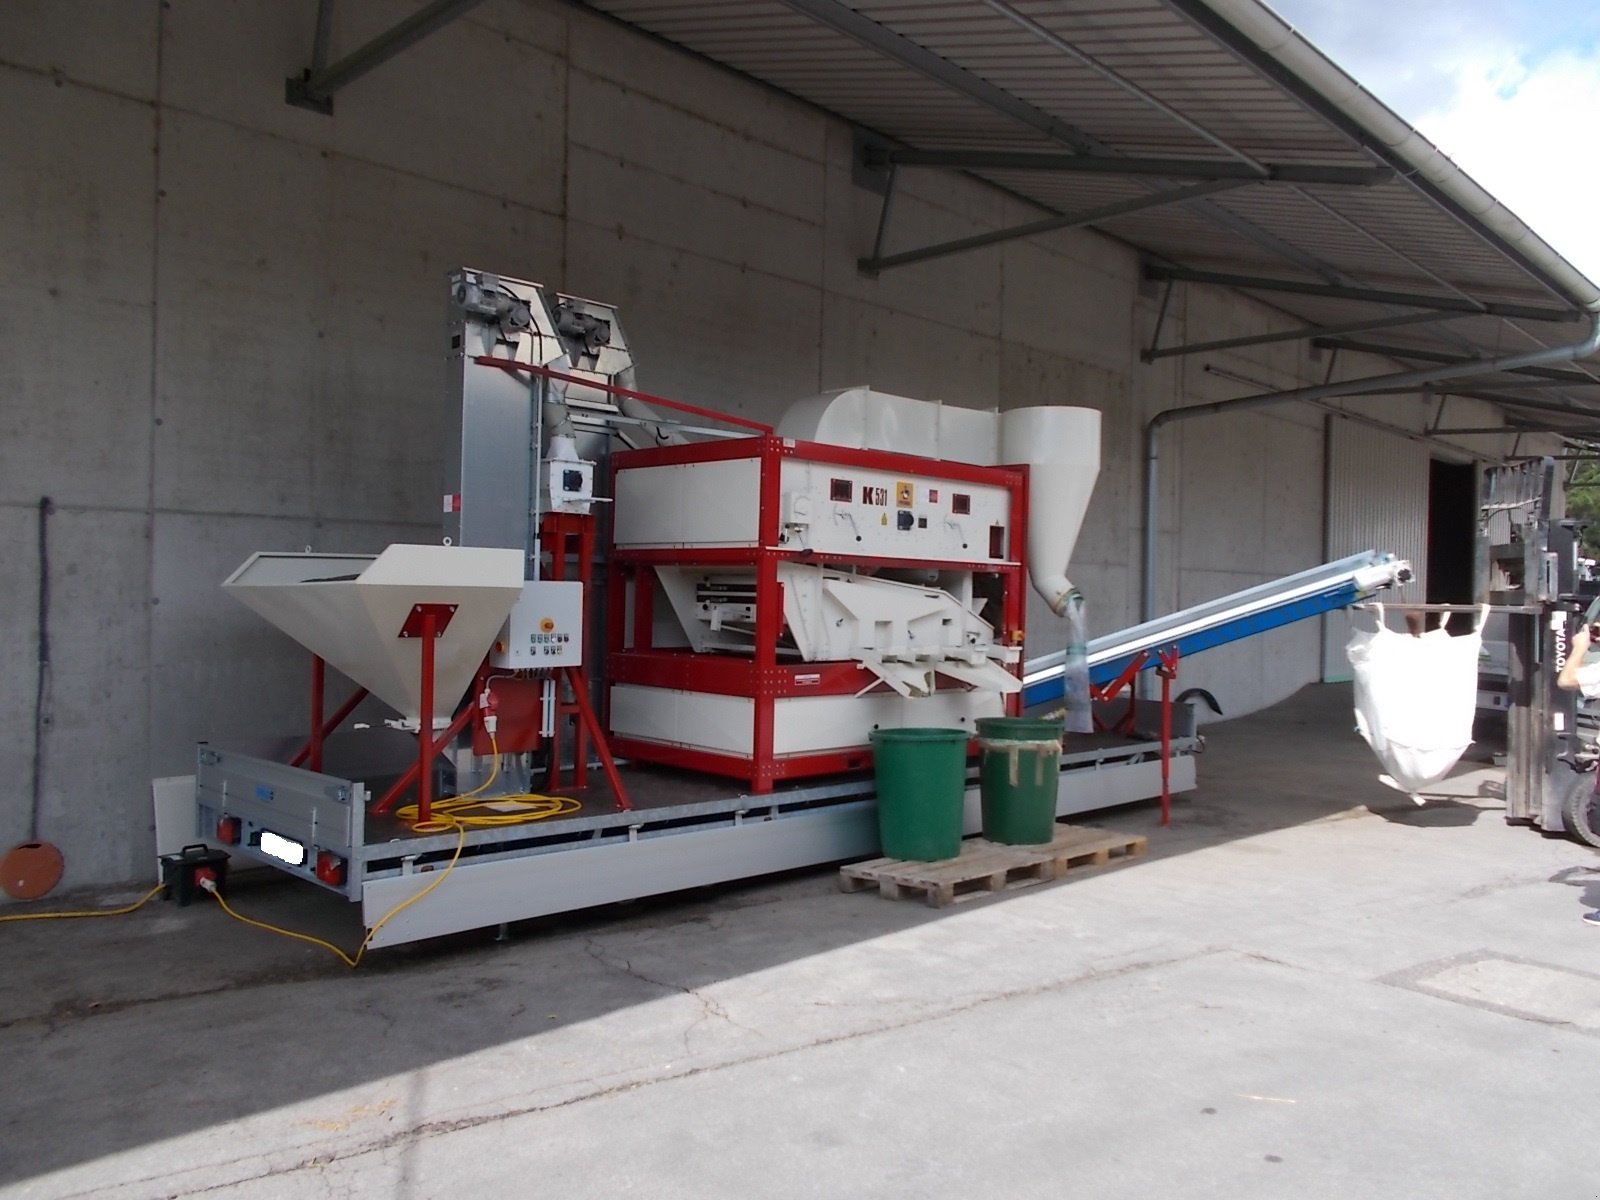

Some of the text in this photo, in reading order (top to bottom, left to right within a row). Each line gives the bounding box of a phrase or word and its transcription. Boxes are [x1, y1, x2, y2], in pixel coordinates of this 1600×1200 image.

[863, 486, 888, 506] K 531
[1555, 628, 1566, 672] TOYOTA
